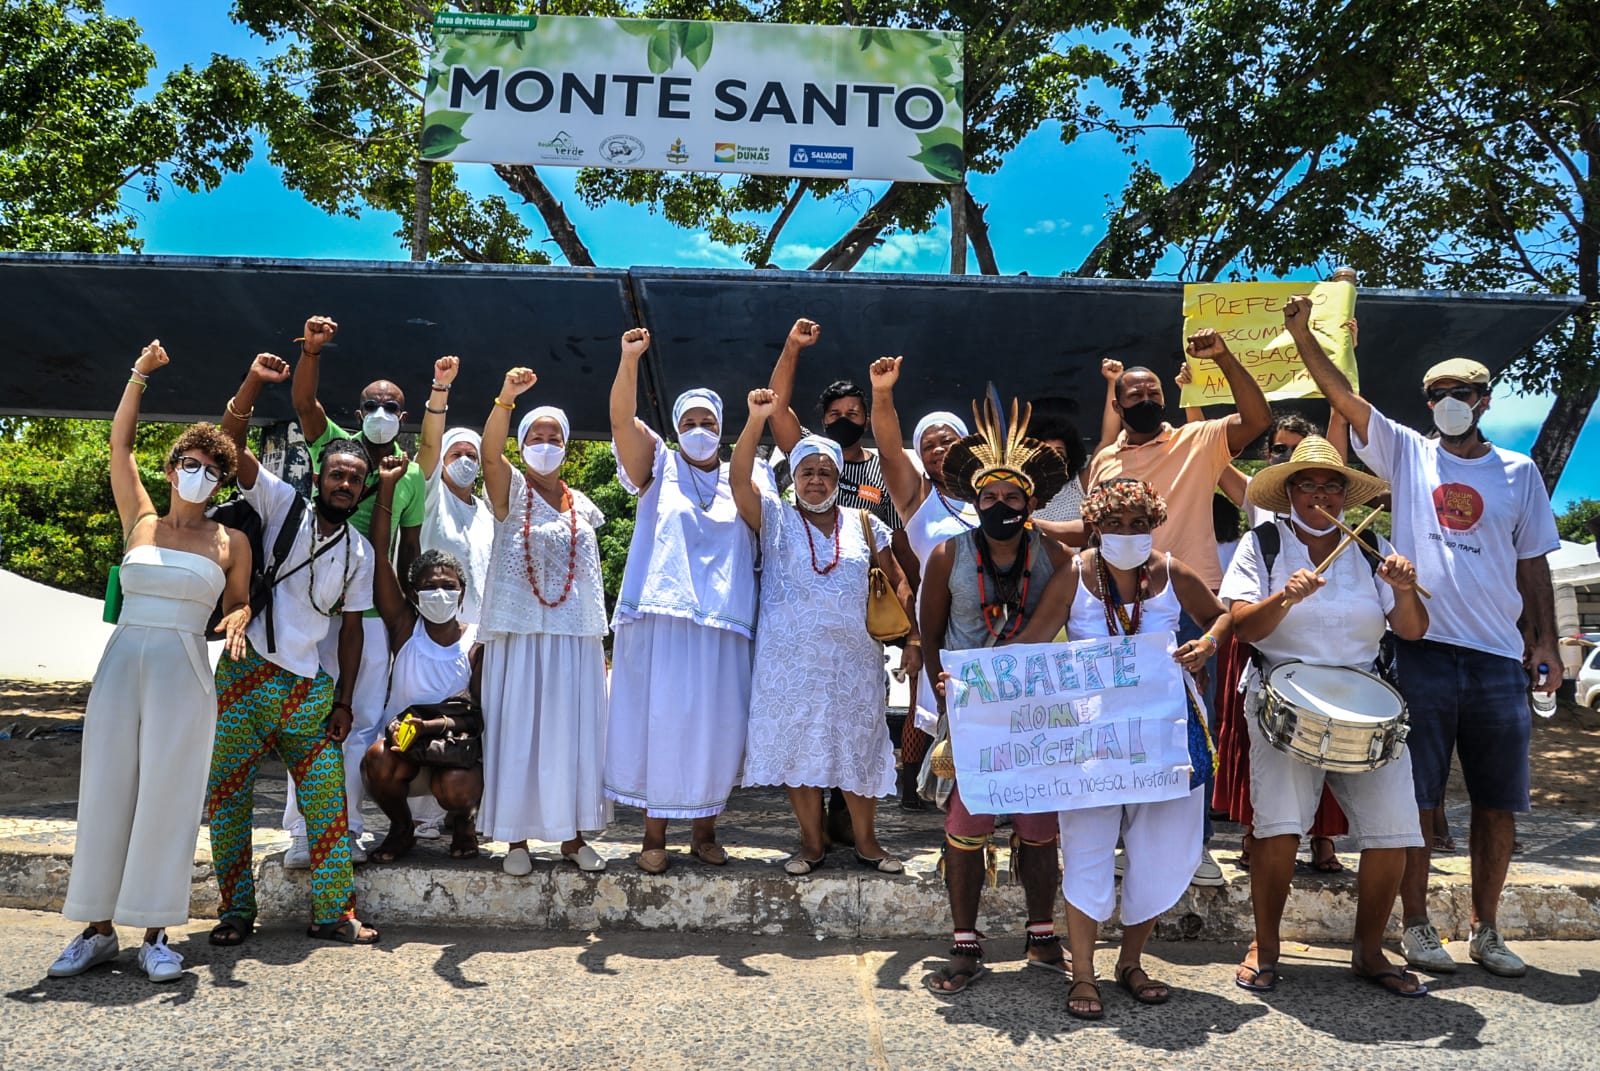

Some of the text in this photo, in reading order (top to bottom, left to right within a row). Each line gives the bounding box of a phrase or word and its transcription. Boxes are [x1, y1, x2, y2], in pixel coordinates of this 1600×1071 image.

[437, 15, 530, 28] Área de Proteção Ambiental
[449, 67, 944, 130] MONTE SANTO
[737, 145, 758, 153] Parque
[737, 151, 770, 161] DUNAS
[811, 151, 848, 161] SALVADOR
[955, 638, 1140, 708] ABAETÉ
[1010, 698, 1091, 733] NOME
[980, 717, 1147, 773] INDÍGENA!
[988, 770, 1179, 808] Respeita nossa história
